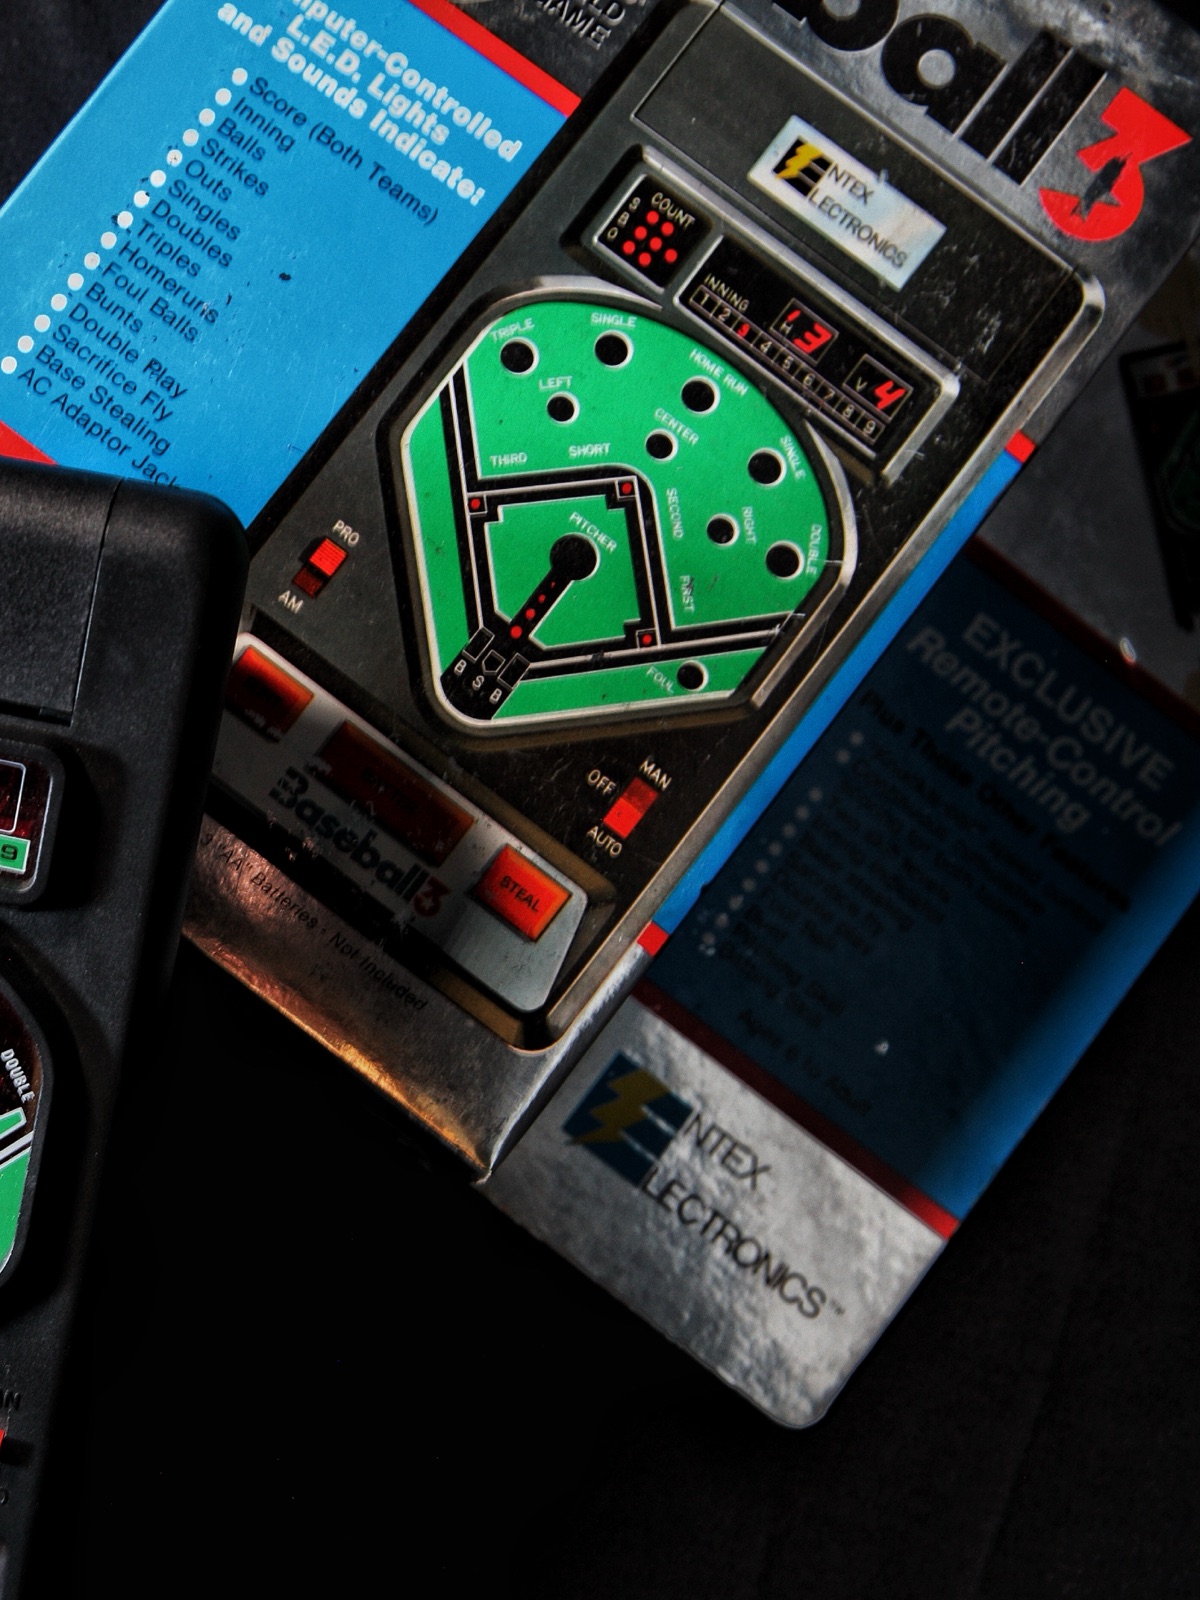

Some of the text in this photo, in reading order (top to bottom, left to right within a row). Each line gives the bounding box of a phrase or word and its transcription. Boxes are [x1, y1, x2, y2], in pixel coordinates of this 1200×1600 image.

[217, 2, 273, 47] and
[271, 36, 368, 119] Sounds
[286, 14, 450, 145] L.E.D. Lights
[217, 117, 266, 162] Balls
[232, 96, 297, 153] Inning
[201, 138, 269, 196] Strikes
[250, 76, 439, 227] Score (Both Teams)
[185, 159, 232, 201] Outs
[152, 199, 233, 268] Doubles
[168, 179, 241, 241] Singles
[617, 211, 630, 228] B
[650, 192, 696, 229] COUNT
[137, 218, 201, 277] Triples
[102, 261, 199, 343] Foul Balls
[119, 240, 219, 324] Homeruns
[704, 273, 750, 312] INNING
[86, 282, 143, 334] Bunts
[490, 318, 535, 343] TRIPLE
[590, 312, 637, 328] SINGLE
[53, 324, 174, 424] Sacrifice Fly
[69, 302, 188, 400] Double Play
[689, 349, 749, 397] HOME RUN
[698, 293, 709, 307] 1
[718, 307, 730, 322] 2
[760, 340, 772, 354] 4
[781, 356, 793, 371] 5
[802, 373, 815, 387] 6
[823, 388, 836, 401] 7
[841, 403, 854, 418] 8
[863, 420, 876, 435] 9
[35, 345, 171, 457] Base Stealing
[538, 376, 573, 391] LEFT
[17, 367, 52, 396] AC
[51, 393, 132, 457] Adaptor
[654, 407, 700, 446] CENTER
[490, 452, 528, 467] THIRD
[568, 443, 611, 459] SHORT
[779, 434, 806, 481] SINGLE
[332, 519, 360, 547] PRO
[569, 512, 618, 553] PITCHER
[666, 487, 684, 541] SECOND
[741, 506, 757, 545] RIGHT
[805, 523, 823, 576] DOUBLE
[278, 590, 304, 614] AM
[679, 574, 695, 614] FIRST
[453, 658, 503, 705] B S B
[645, 666, 675, 694] FOUL
[961, 611, 1177, 792] EXCLUSIVE
[906, 625, 1184, 848] Remote-Control
[587, 768, 617, 796] OFF
[638, 757, 673, 792] MAN
[944, 705, 1093, 835] Pitching
[0, 844, 18, 861] 9
[586, 824, 623, 859] AUTO
[500, 875, 540, 913] STEAL
[250, 871, 318, 930] Batteries
[329, 932, 356, 960] Not
[360, 956, 429, 1011] Included
[0, 1048, 36, 1105] DOUBLE
